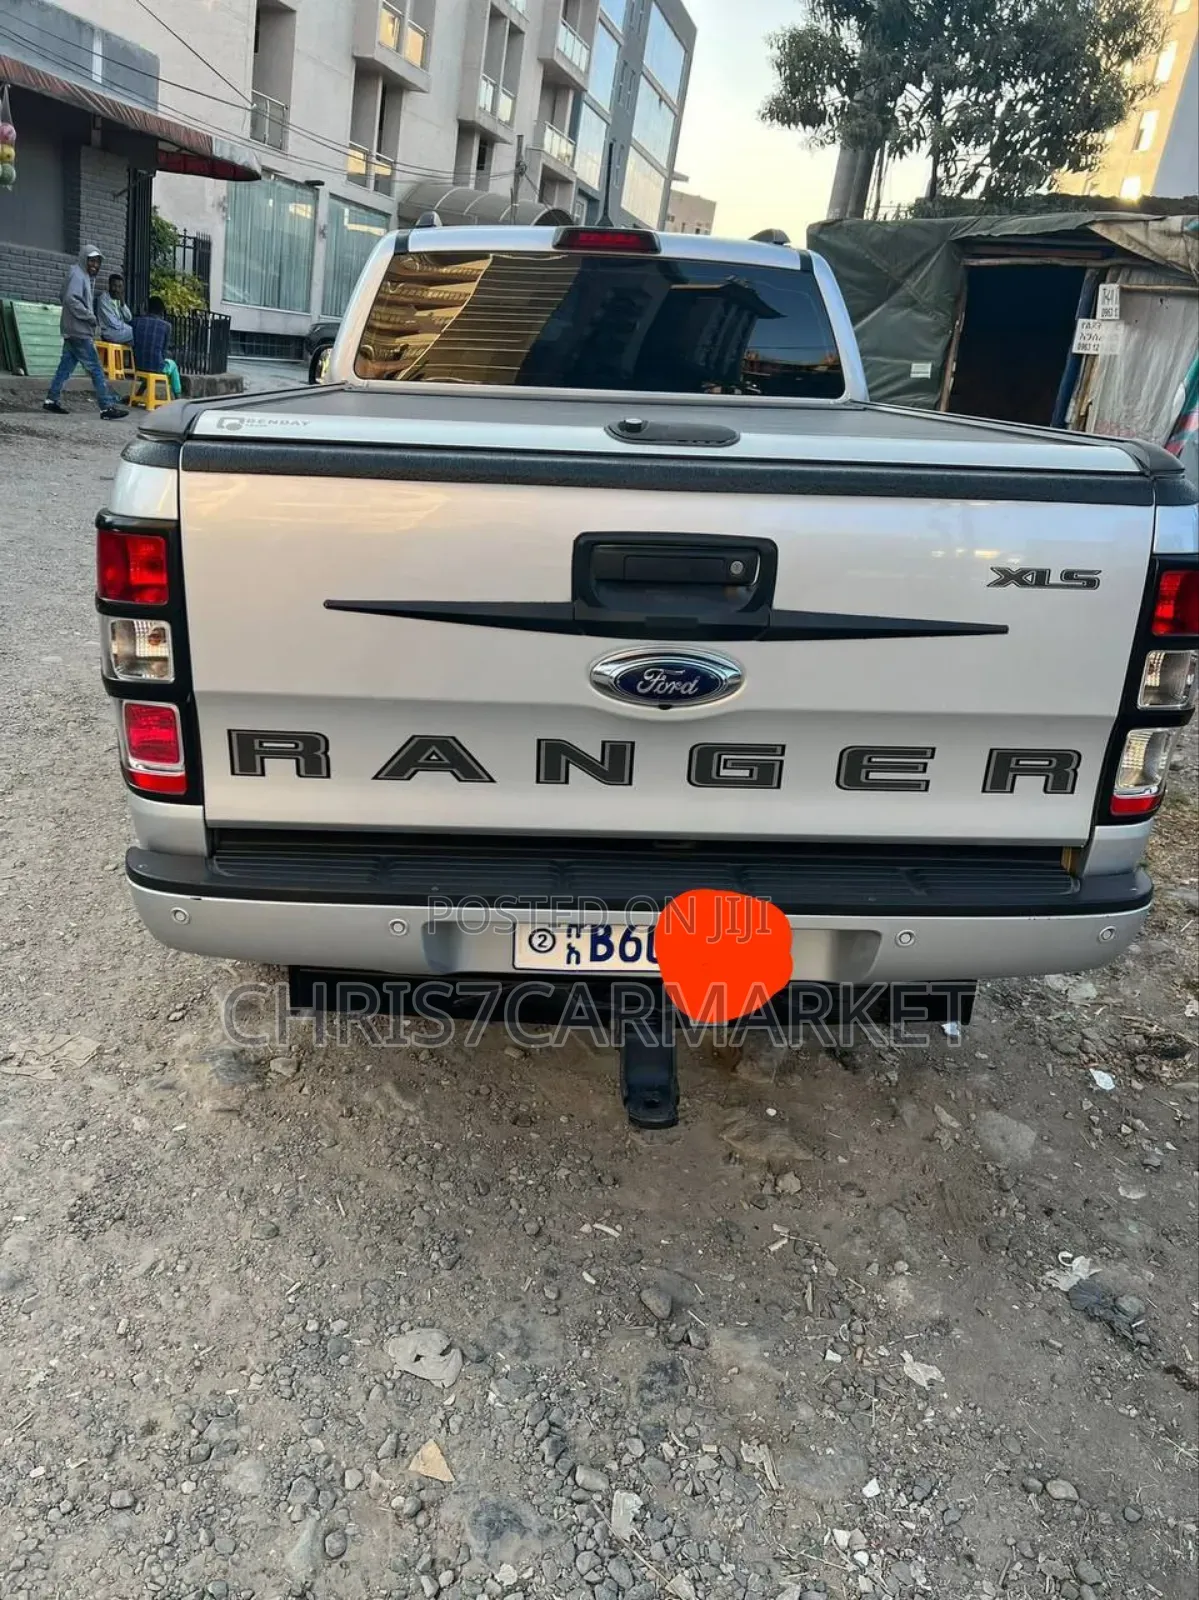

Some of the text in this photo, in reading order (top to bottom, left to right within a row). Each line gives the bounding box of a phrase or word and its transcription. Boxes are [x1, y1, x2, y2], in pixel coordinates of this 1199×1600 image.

[986, 566, 1103, 591] XLS
[636, 668, 701, 695] Ford
[227, 728, 1082, 795] RANGER
